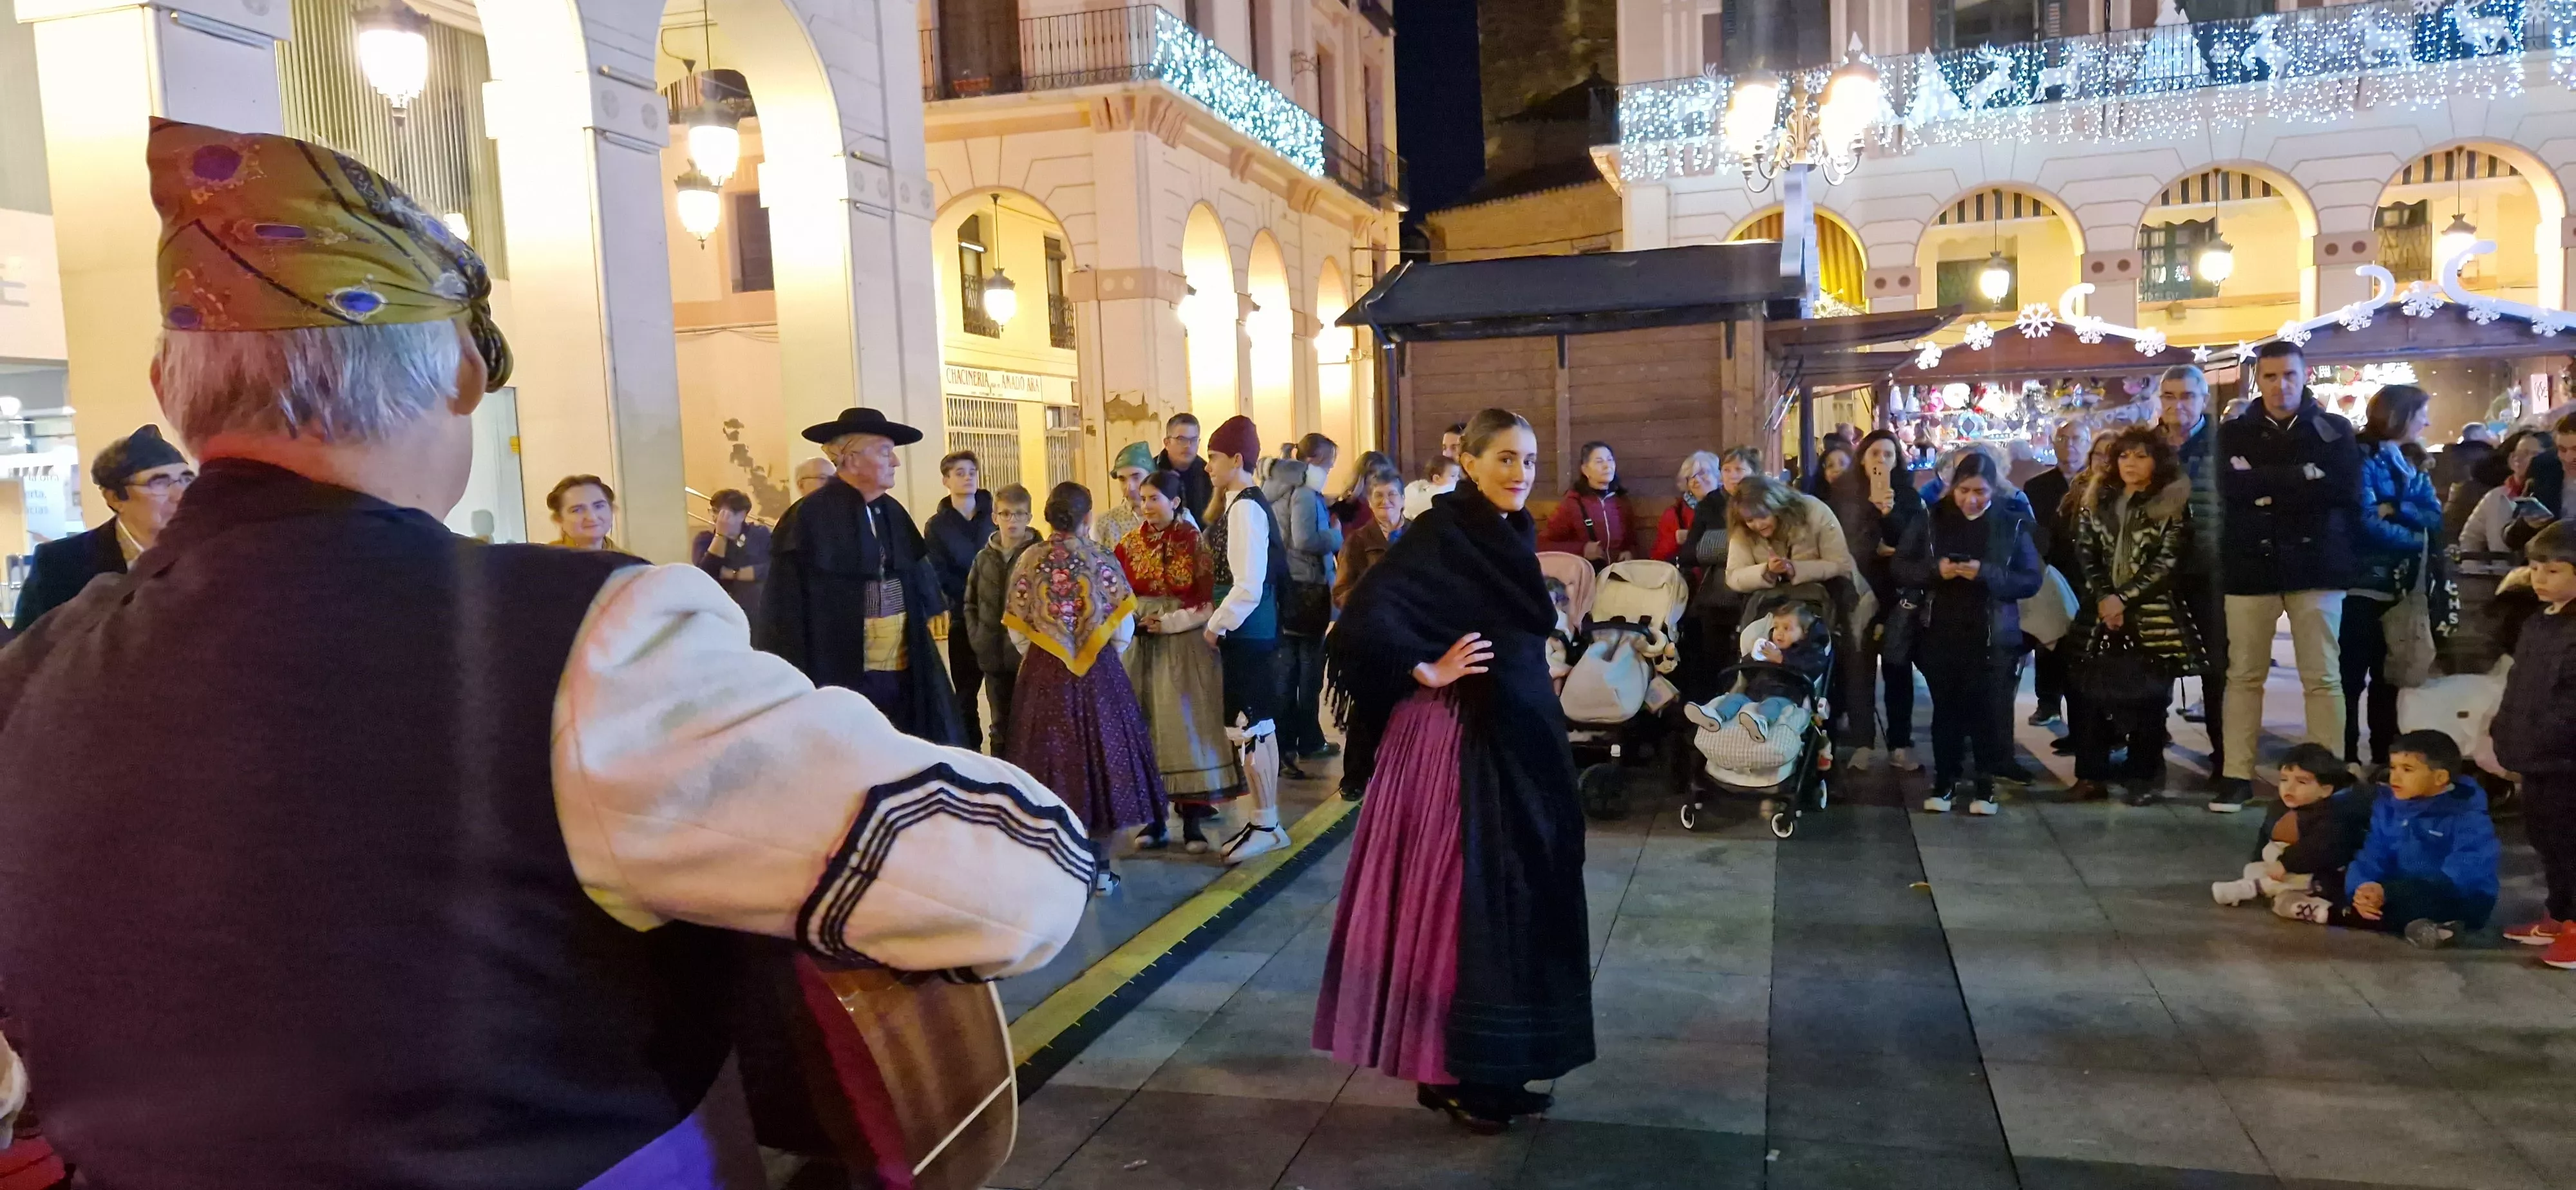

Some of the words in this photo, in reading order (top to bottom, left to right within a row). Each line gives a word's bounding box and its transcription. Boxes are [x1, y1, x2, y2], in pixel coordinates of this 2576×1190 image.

[946, 368, 989, 388] CHACINERIA
[1002, 373, 1025, 390] AMADO
[1027, 377, 1040, 392] ARA
